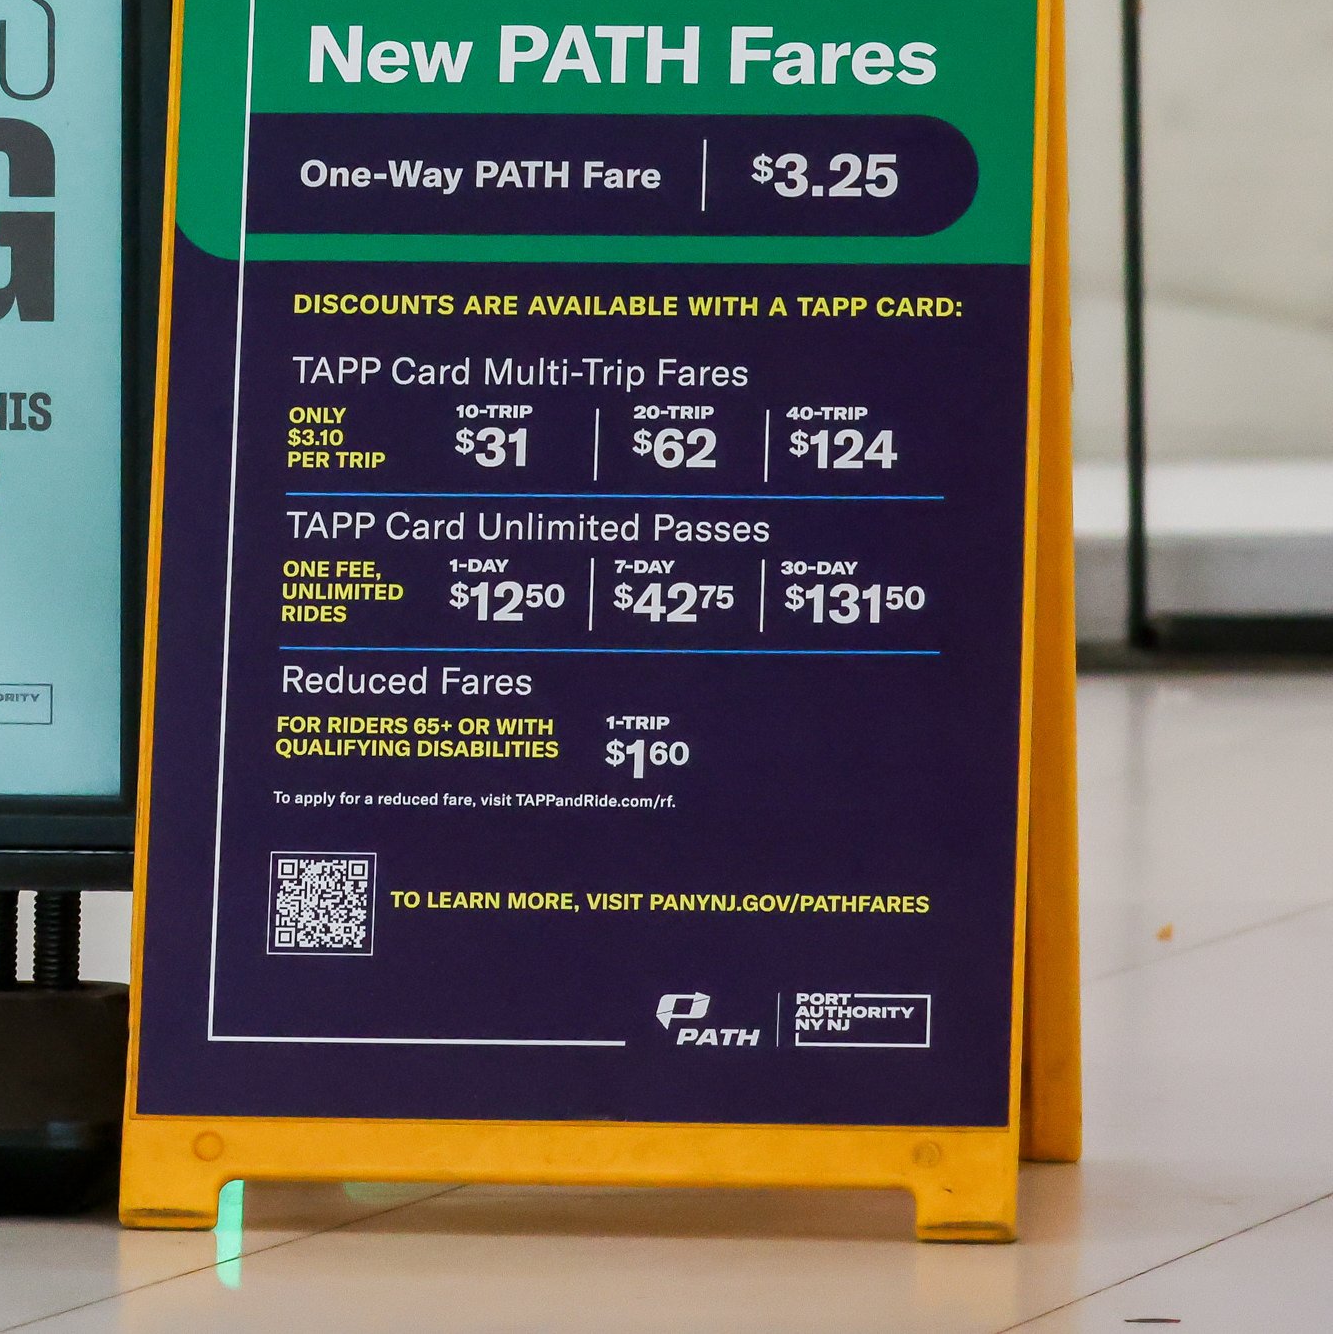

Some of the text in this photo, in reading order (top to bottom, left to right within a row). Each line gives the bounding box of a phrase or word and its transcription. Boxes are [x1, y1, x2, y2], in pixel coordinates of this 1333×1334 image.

[309, 25, 936, 85] New PATH Fares
[301, 160, 660, 194] One-Way PATH Fare
[751, 153, 898, 197] $3.25
[294, 294, 961, 317] DISCOUNTS ARE AVAILABLE WITH A TAPP CARD:
[293, 357, 747, 392] TAPP Card Multi-Trip Fares
[290, 407, 346, 423] ONLY
[456, 405, 532, 418] 10-TRIP
[634, 406, 714, 419] 20-TRIP
[786, 407, 867, 420] 40-TRIP
[288, 428, 343, 446] $3.10
[455, 427, 526, 467] $31
[633, 428, 716, 468] $62
[789, 429, 897, 468] $124
[288, 451, 385, 468] PER TRIP
[287, 512, 769, 542] TAPP Card Unlimited Passes
[284, 561, 380, 580] ONE FEE,
[450, 559, 508, 572] 1-DAY
[615, 560, 675, 573] 7-DAY
[781, 561, 858, 575] 30-DAY
[283, 583, 403, 600] UNLIMITED
[282, 606, 346, 622] RIDES
[283, 666, 531, 695] Reduced Fares
[278, 717, 553, 735] FOR RIDERS 65+ OR WITH
[607, 716, 669, 730] 1-TRIP
[276, 739, 558, 758] QUALIFYING DISABILITIES
[273, 791, 675, 809] To apply for a reduced fare, visit TAPPandRide.com/rf.
[391, 891, 929, 913] TO LEARN MORE, VISIT PANYNJ.GOV/PATHFARES
[796, 993, 852, 1006] PORT
[795, 1006, 915, 1019] AUTHORITY
[795, 1019, 851, 1032] NY NJ
[676, 1028, 760, 1046] PATH
